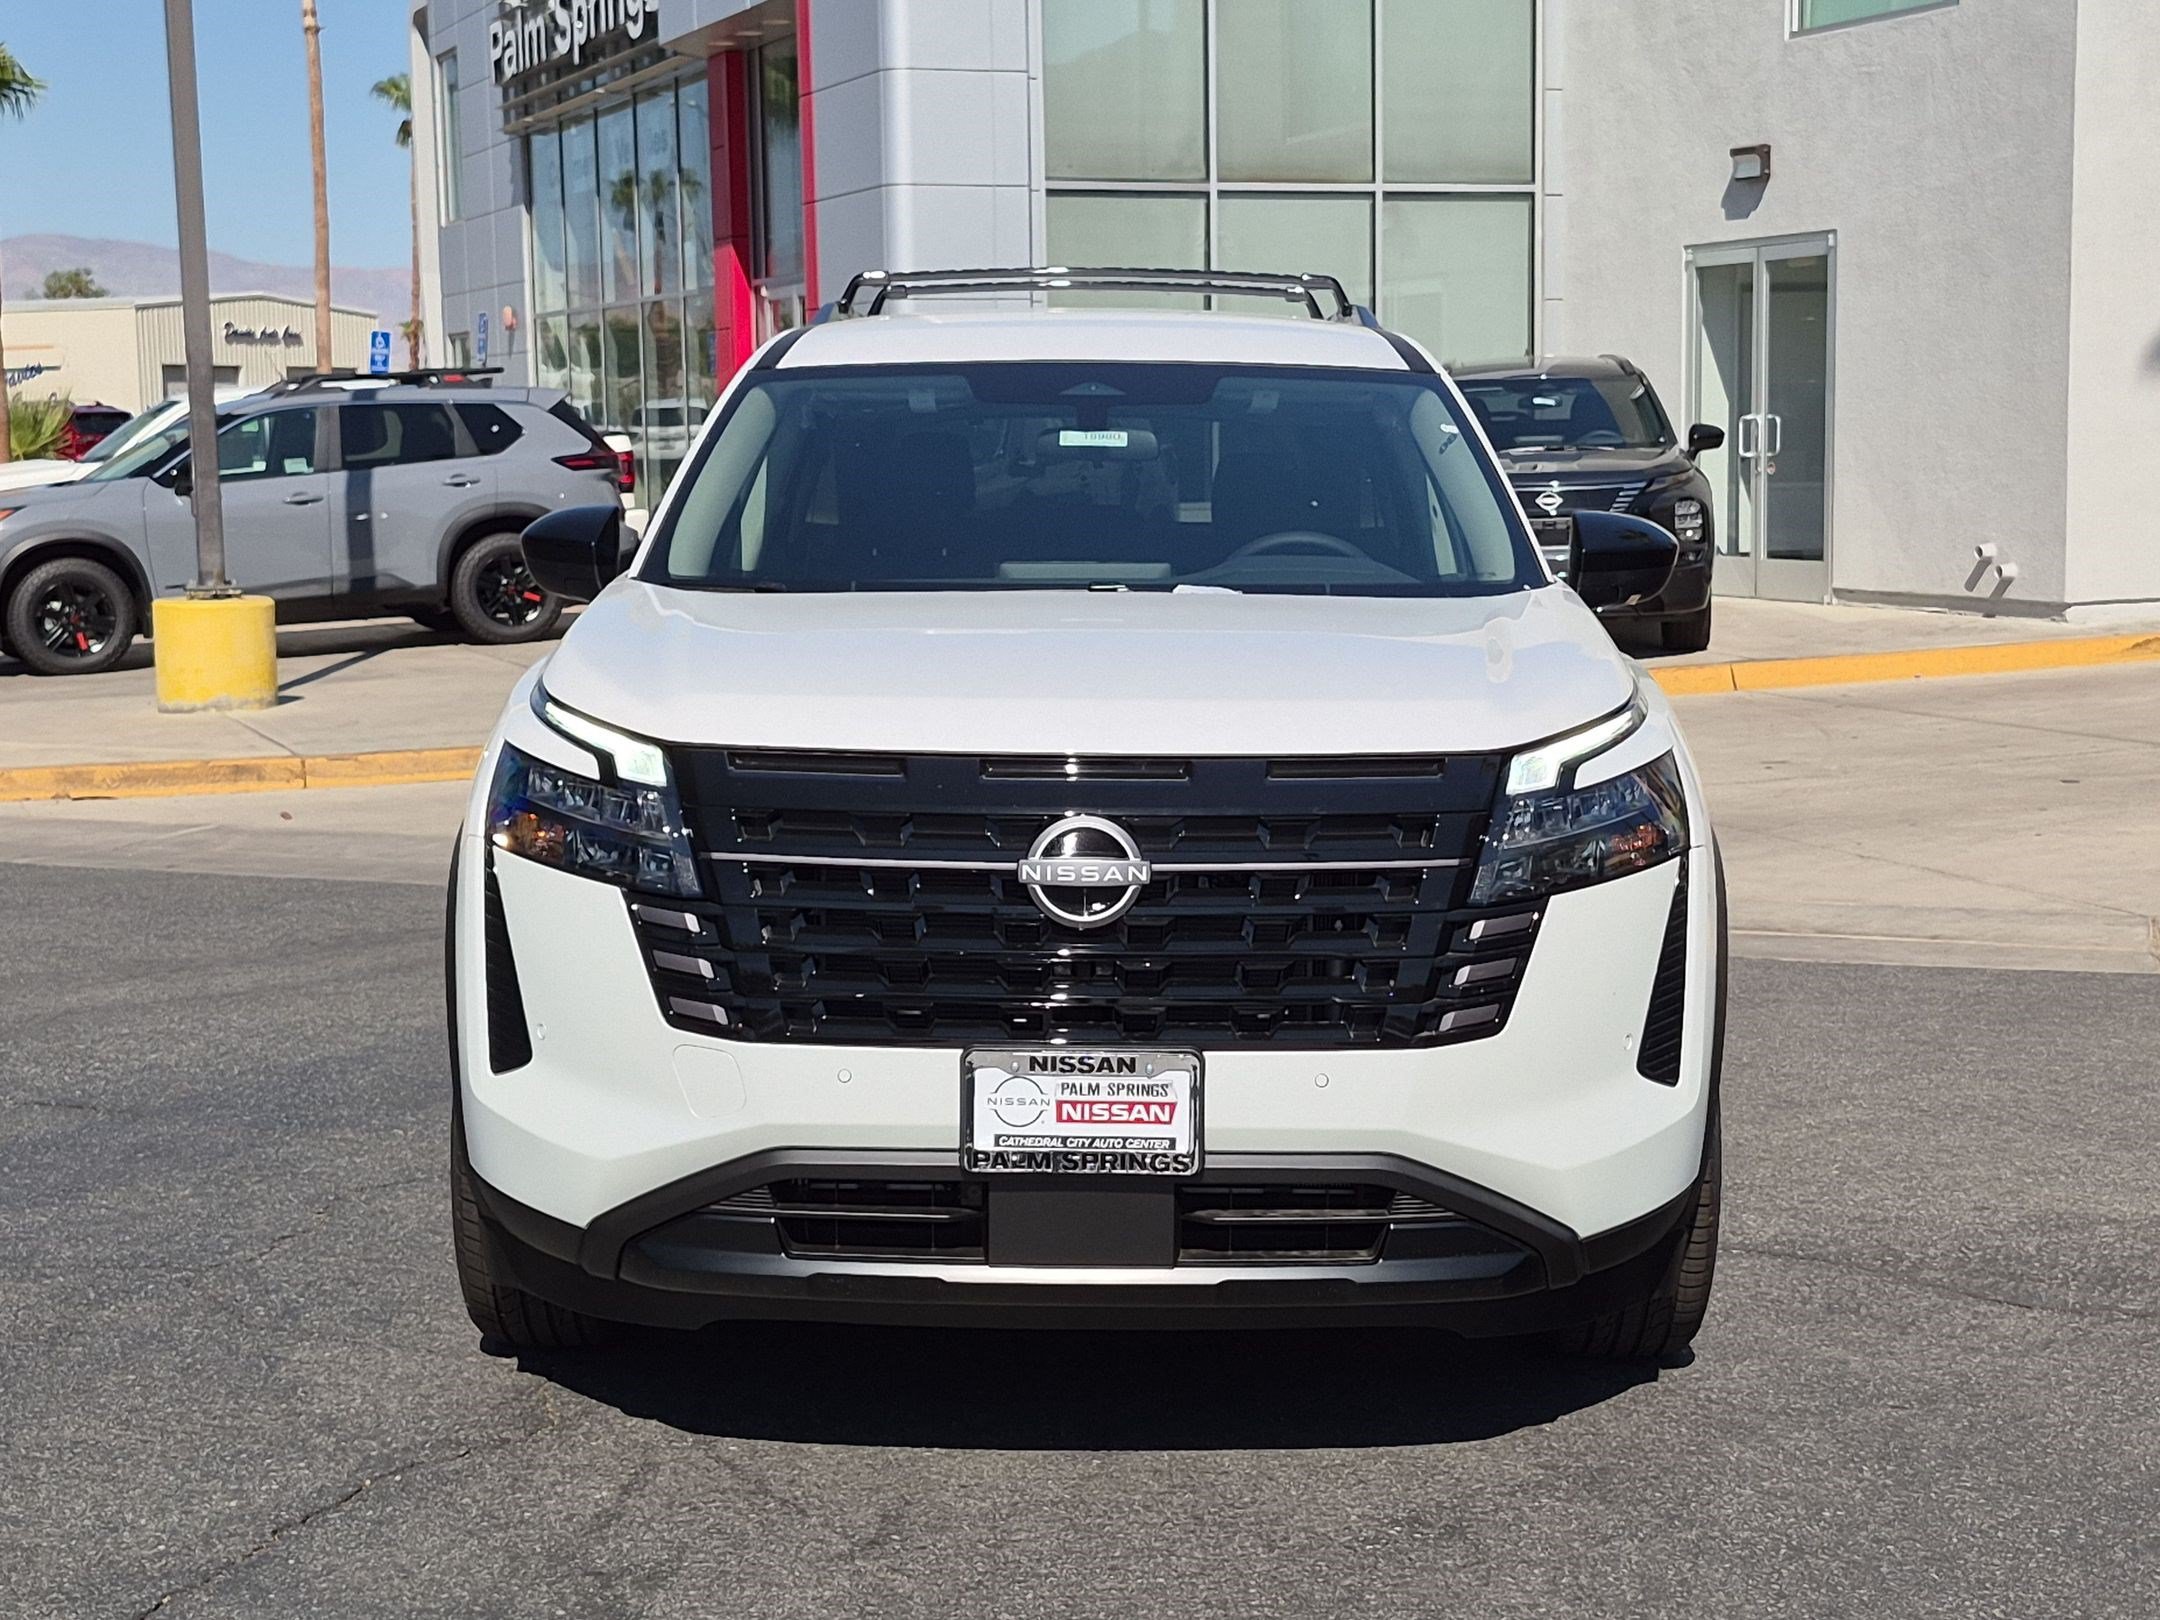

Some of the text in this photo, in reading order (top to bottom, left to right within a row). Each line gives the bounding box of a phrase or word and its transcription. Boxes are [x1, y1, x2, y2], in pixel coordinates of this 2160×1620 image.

[490, 8, 547, 84] Palm
[1021, 864, 1147, 882] NISSAN
[1029, 1055, 1136, 1074] NISSAN
[1060, 1082, 1169, 1098] PALM SPRINGS
[987, 1097, 1051, 1107] NISSAN
[1061, 1102, 1171, 1122] NISSAN
[998, 1135, 1170, 1150] CATHEDRAL CITY AUTO CENTER
[973, 1151, 1192, 1173] PALM SPRINGS
